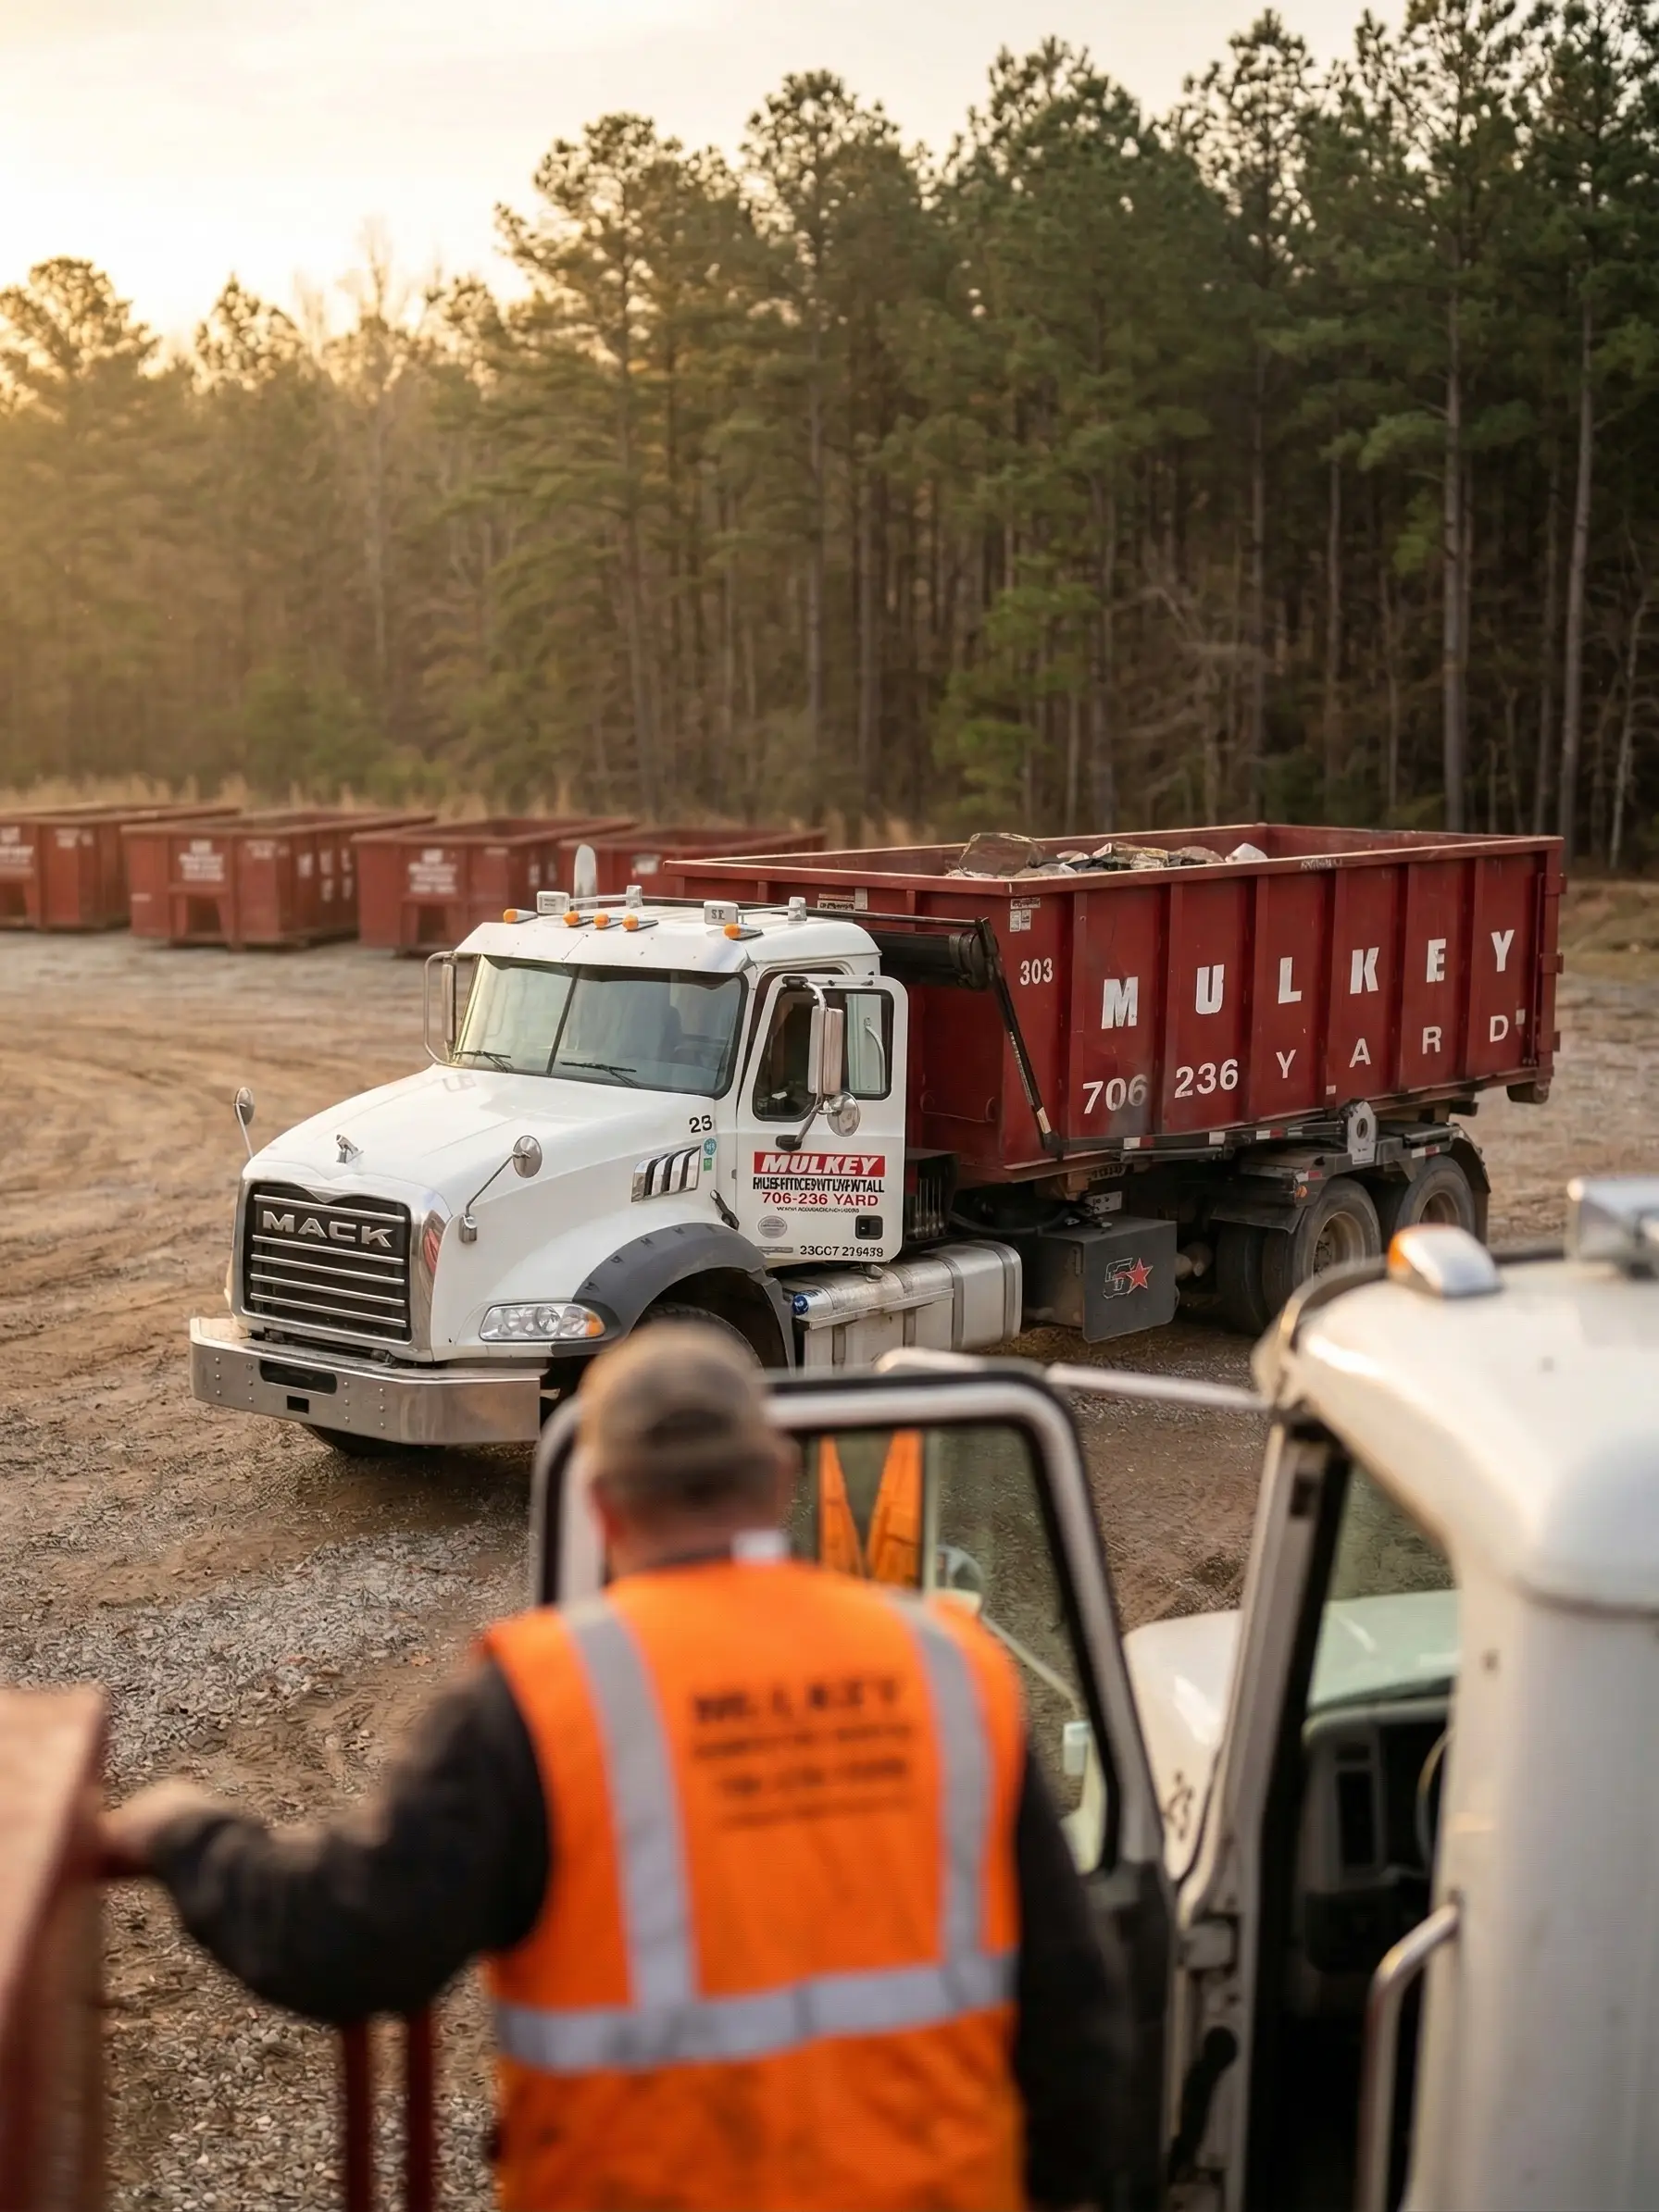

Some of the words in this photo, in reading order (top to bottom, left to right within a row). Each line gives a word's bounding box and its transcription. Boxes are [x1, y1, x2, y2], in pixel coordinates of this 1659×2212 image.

[1019, 957, 1054, 986] 303
[1102, 930, 1515, 1029] MULKEY
[1082, 1074, 1148, 1114] 706
[1175, 1059, 1239, 1099] 236
[1276, 1014, 1509, 1079] YARD
[689, 1114, 713, 1134] 23
[761, 1154, 879, 1175] MULKEY
[762, 1191, 828, 1206] 706-236
[833, 1193, 879, 1207] YARD
[262, 1210, 393, 1249] MACK
